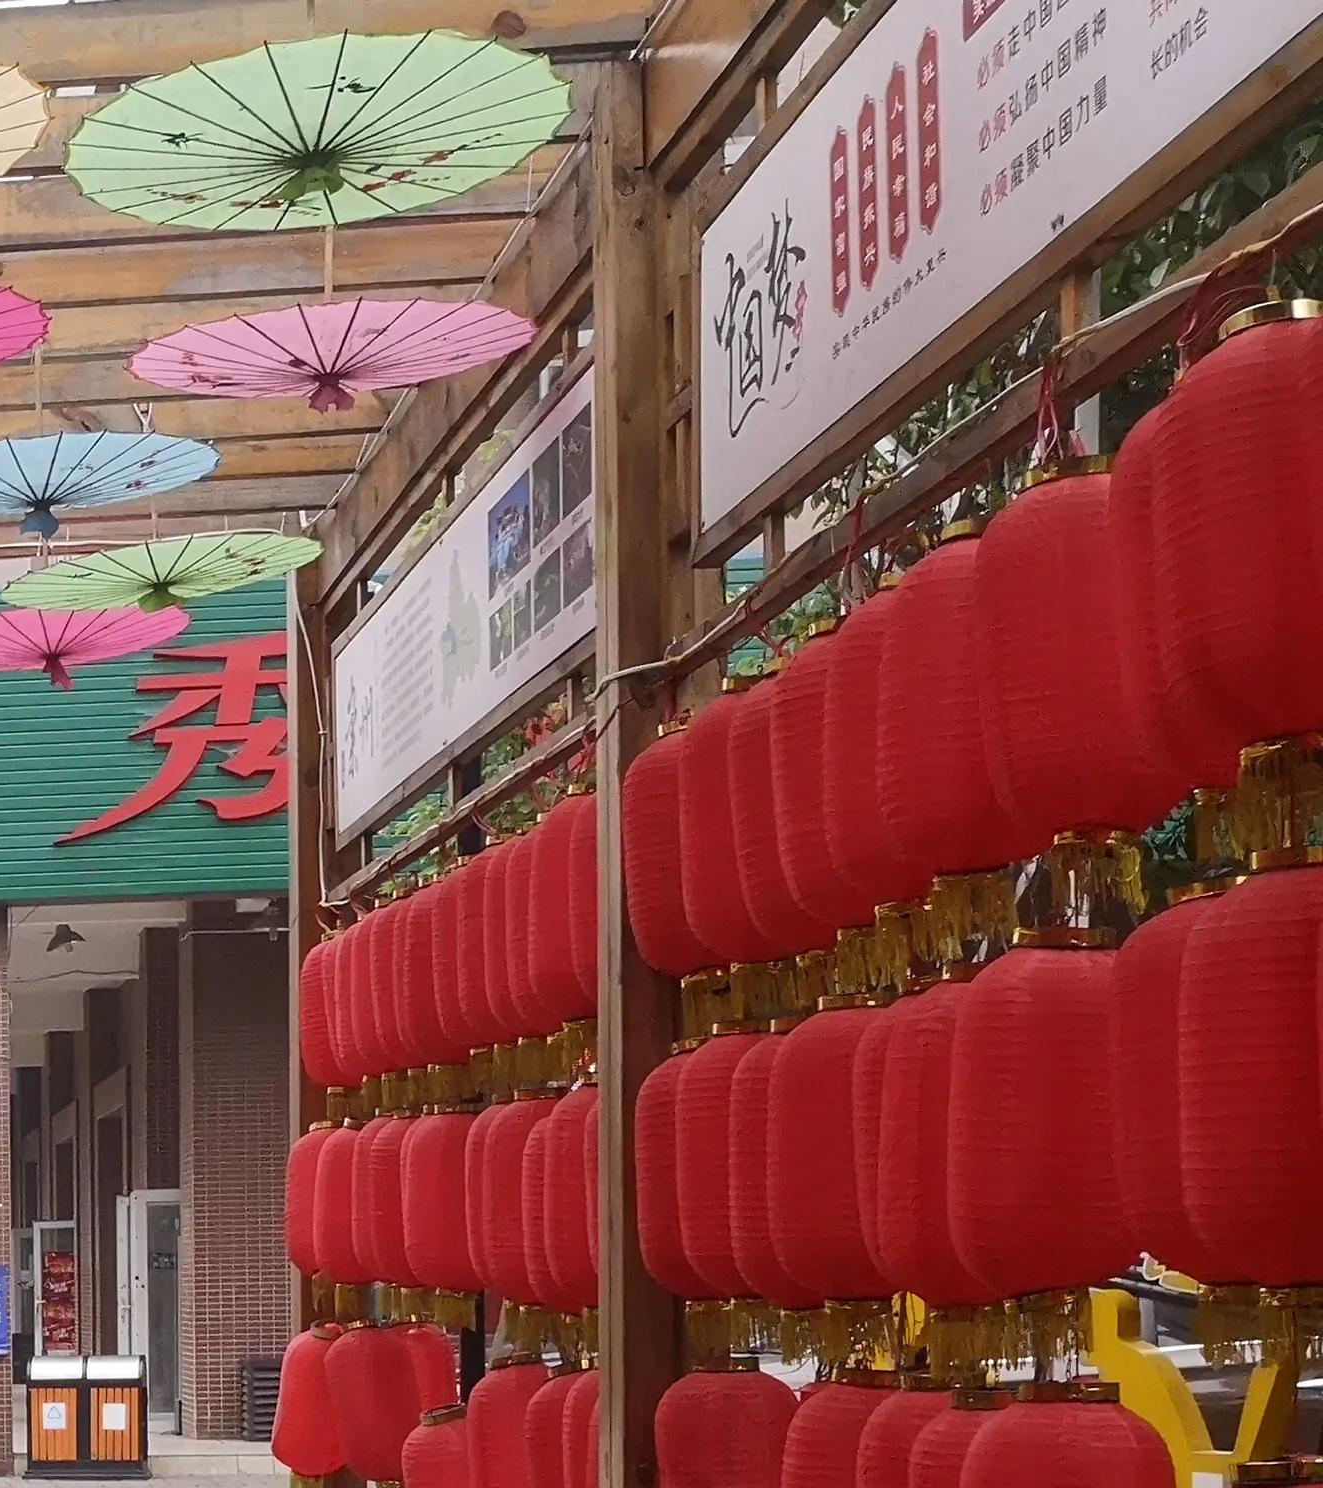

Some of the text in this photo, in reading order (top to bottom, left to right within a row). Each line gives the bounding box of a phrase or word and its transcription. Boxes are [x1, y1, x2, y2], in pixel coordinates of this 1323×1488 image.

[978, 0, 1070, 90] 必须走中国
[1151, 6, 1209, 81] 长的机会
[979, 75, 1108, 217] 必须凝聚中国力量
